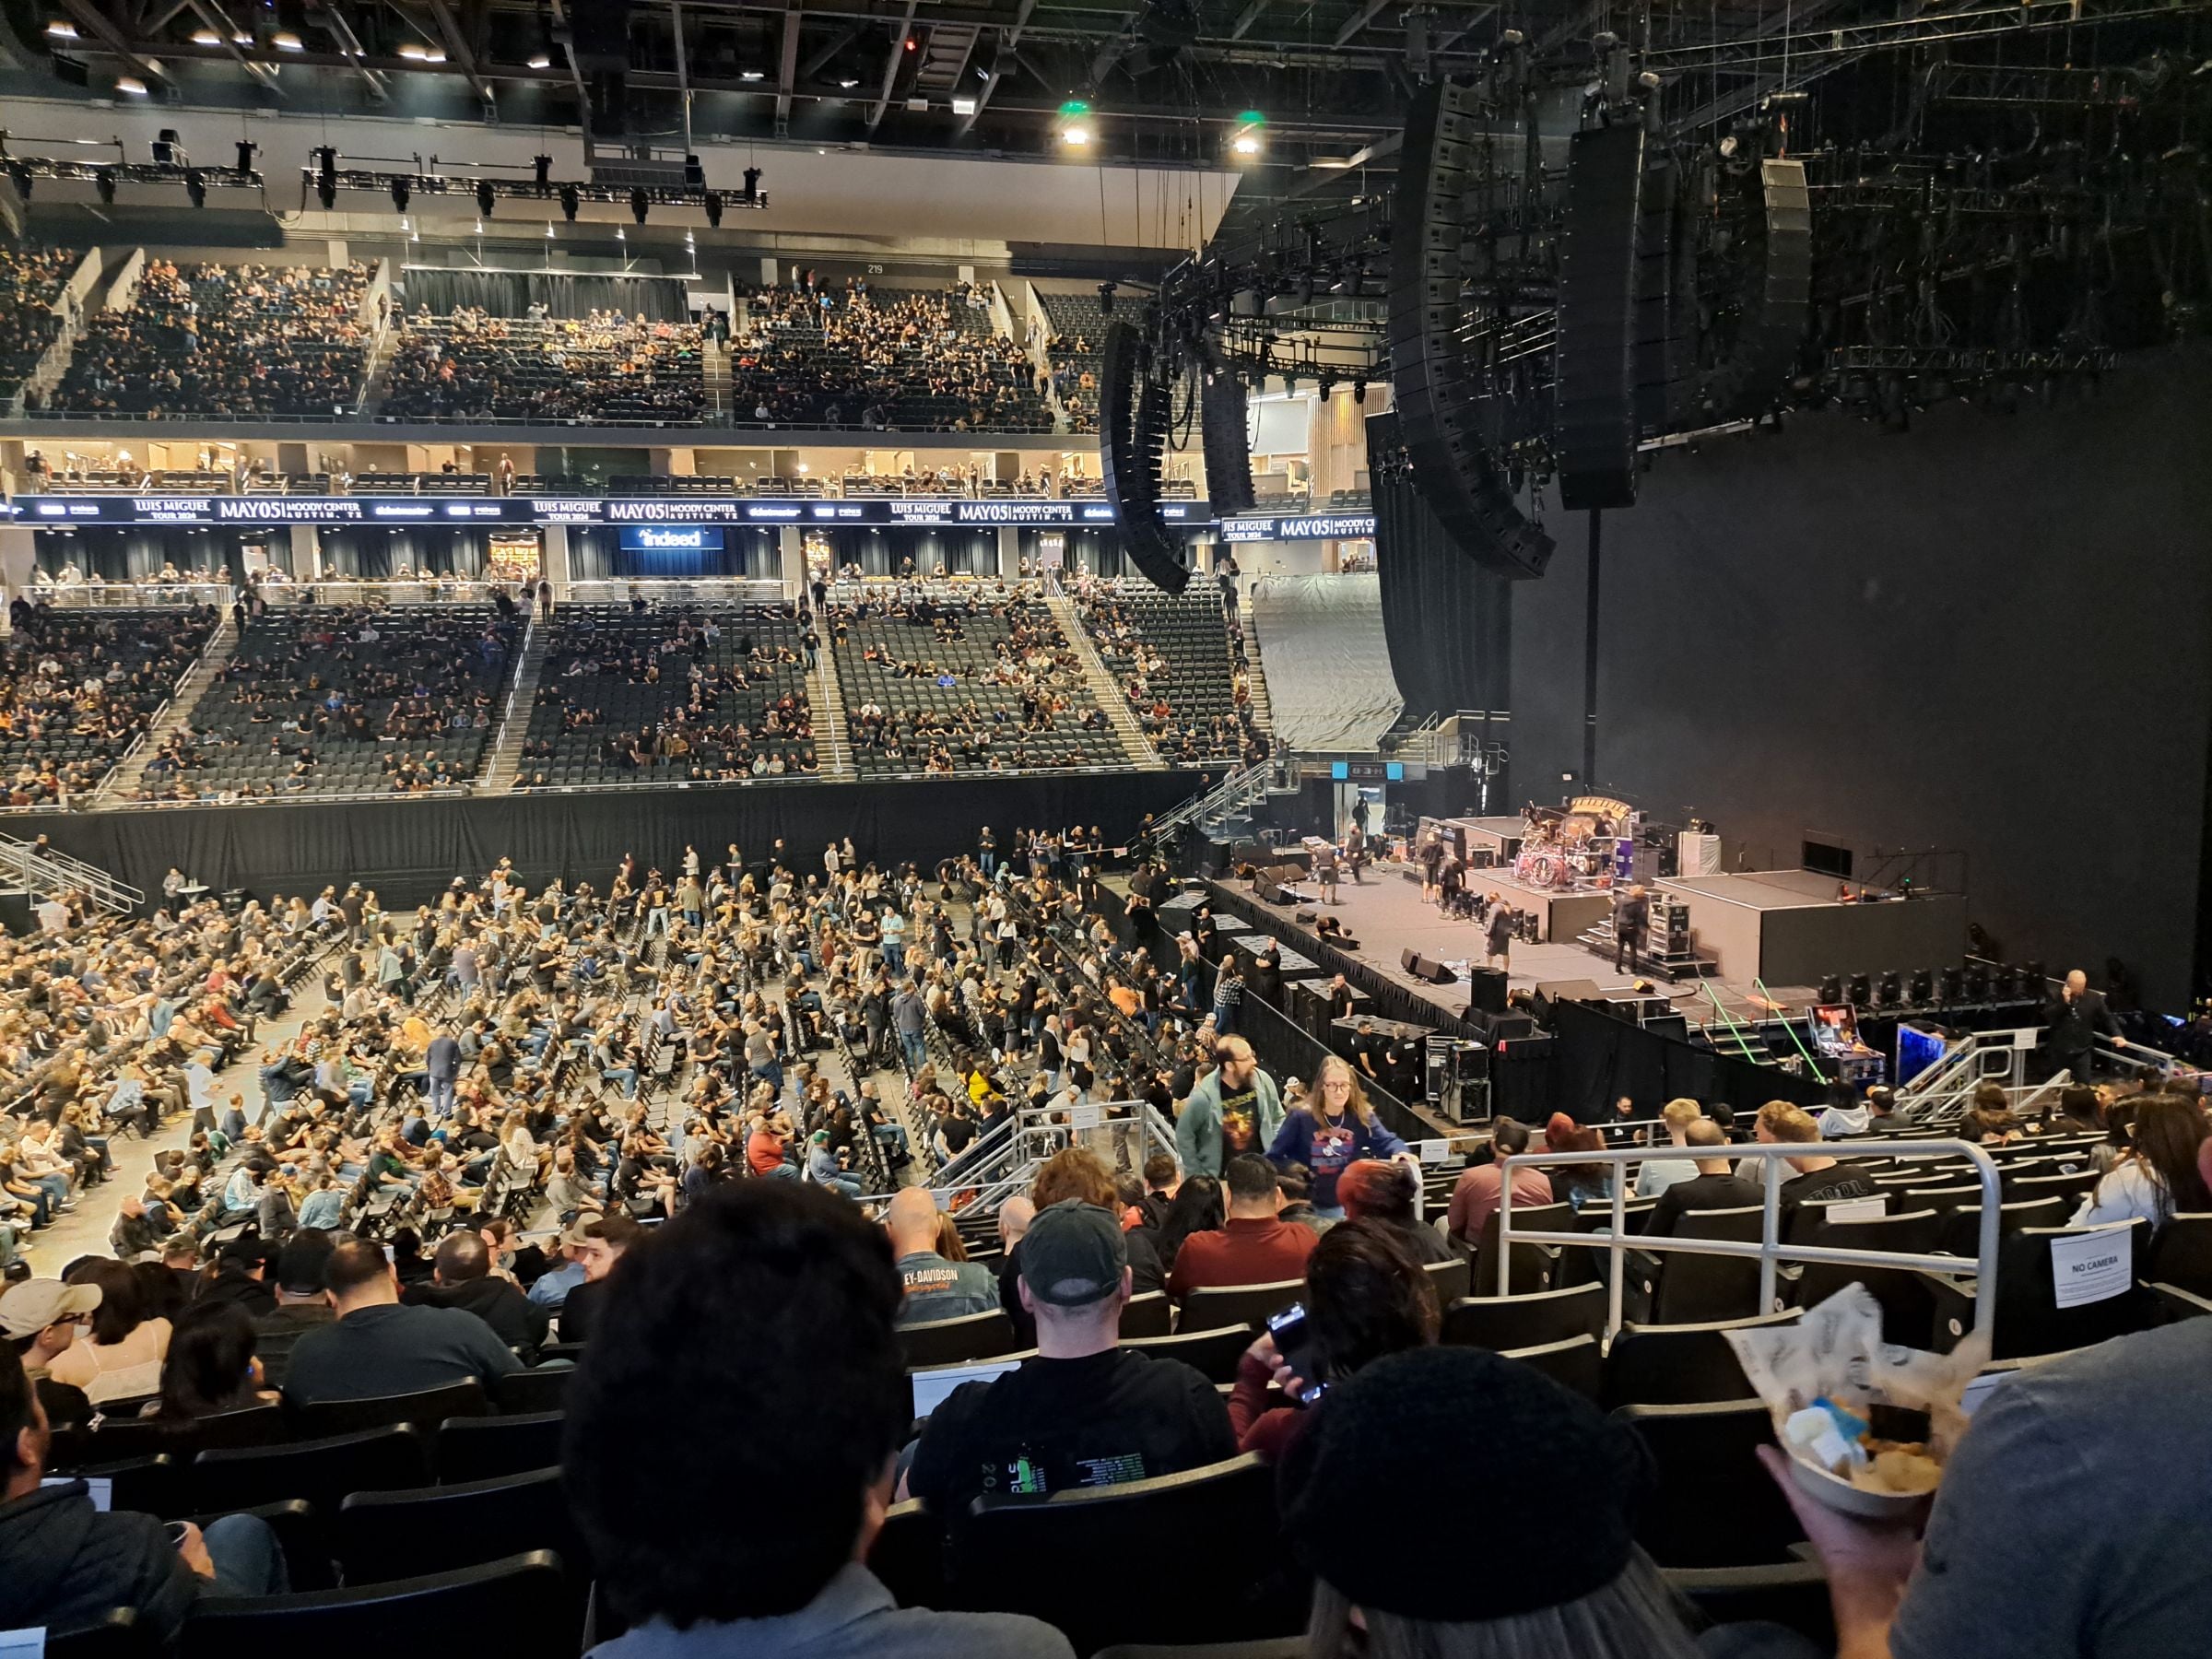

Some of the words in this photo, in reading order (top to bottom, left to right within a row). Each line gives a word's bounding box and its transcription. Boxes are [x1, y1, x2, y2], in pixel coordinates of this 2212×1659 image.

[867, 265, 883, 274] 219
[135, 501, 162, 512] LUIS
[163, 501, 211, 512] MIGUEL
[286, 502, 323, 512] MOODY
[323, 502, 360, 512] CENTER
[535, 502, 559, 512] LUIS
[559, 502, 602, 512] MIGUEL
[670, 504, 703, 512] MOODY
[703, 504, 736, 512] CENTER
[891, 504, 913, 513] LUIS
[914, 504, 951, 513] MIGUEL
[1013, 505, 1042, 513] MOODY
[1042, 505, 1072, 514] CENTER
[151, 512, 177, 520] TOUR
[1236, 521, 1273, 532] MIGUEL
[1334, 519, 1364, 527] MOODY
[639, 529, 700, 547] indeed
[2071, 1263, 2086, 1273] NO
[2087, 1255, 2119, 1270] CAMERA
